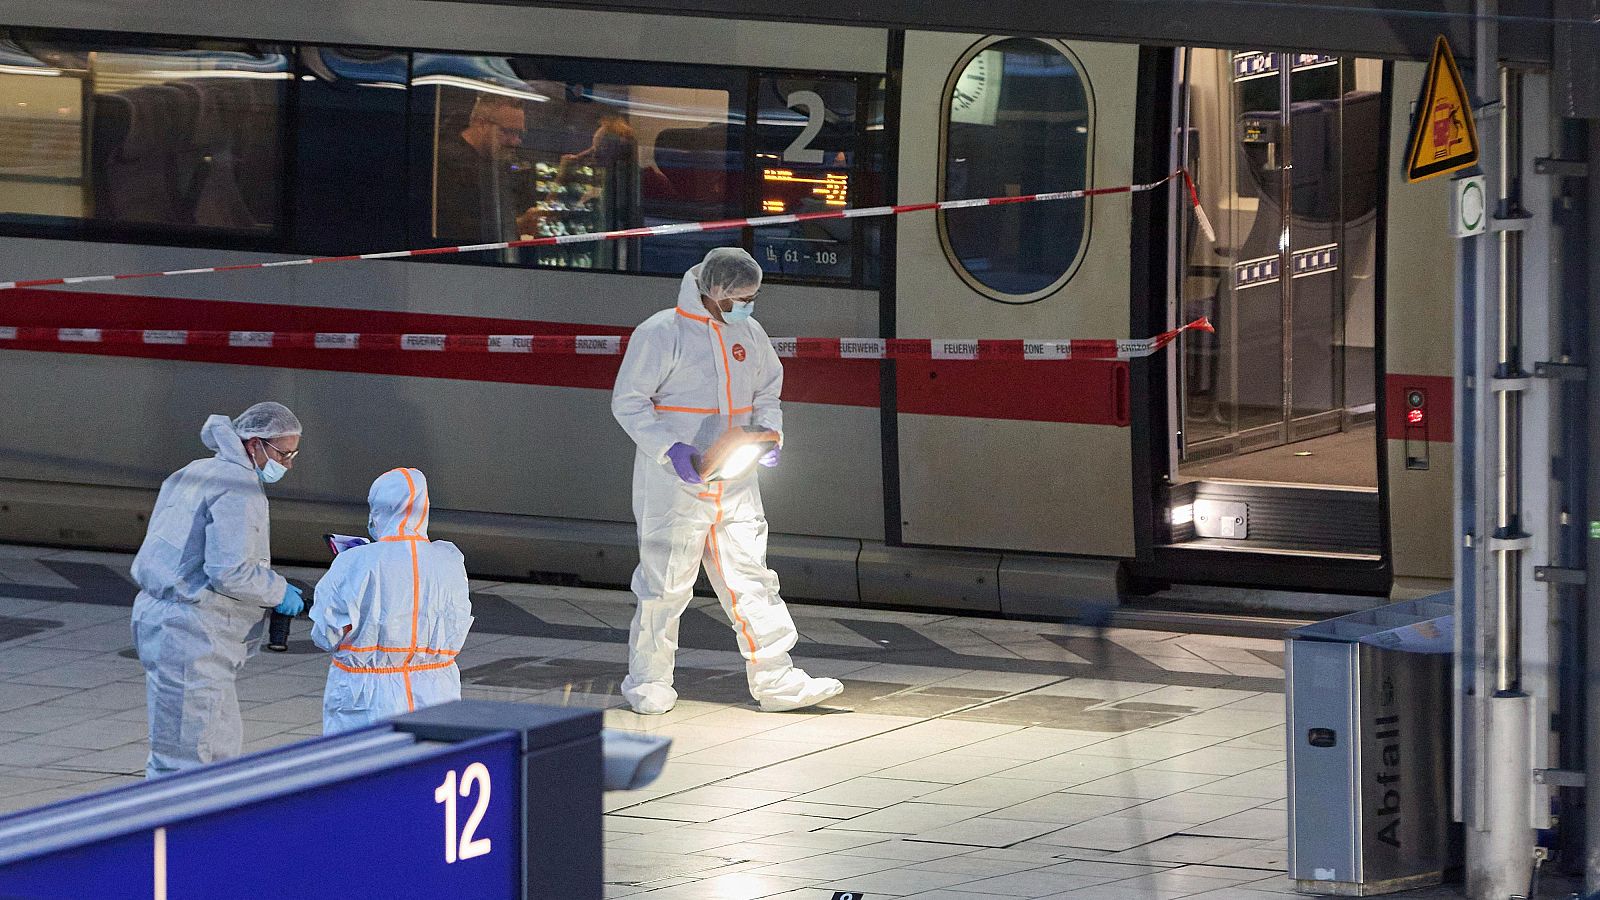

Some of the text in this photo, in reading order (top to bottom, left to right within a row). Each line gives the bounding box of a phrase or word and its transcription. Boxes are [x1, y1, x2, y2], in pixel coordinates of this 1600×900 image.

[783, 90, 825, 163] 2
[784, 251, 799, 263] 61
[815, 252, 838, 265] 108
[407, 334, 447, 347] FEUERWE
[944, 343, 988, 355] FEUERWE
[435, 762, 491, 864] 12
[1376, 715, 1400, 849] Abfall
